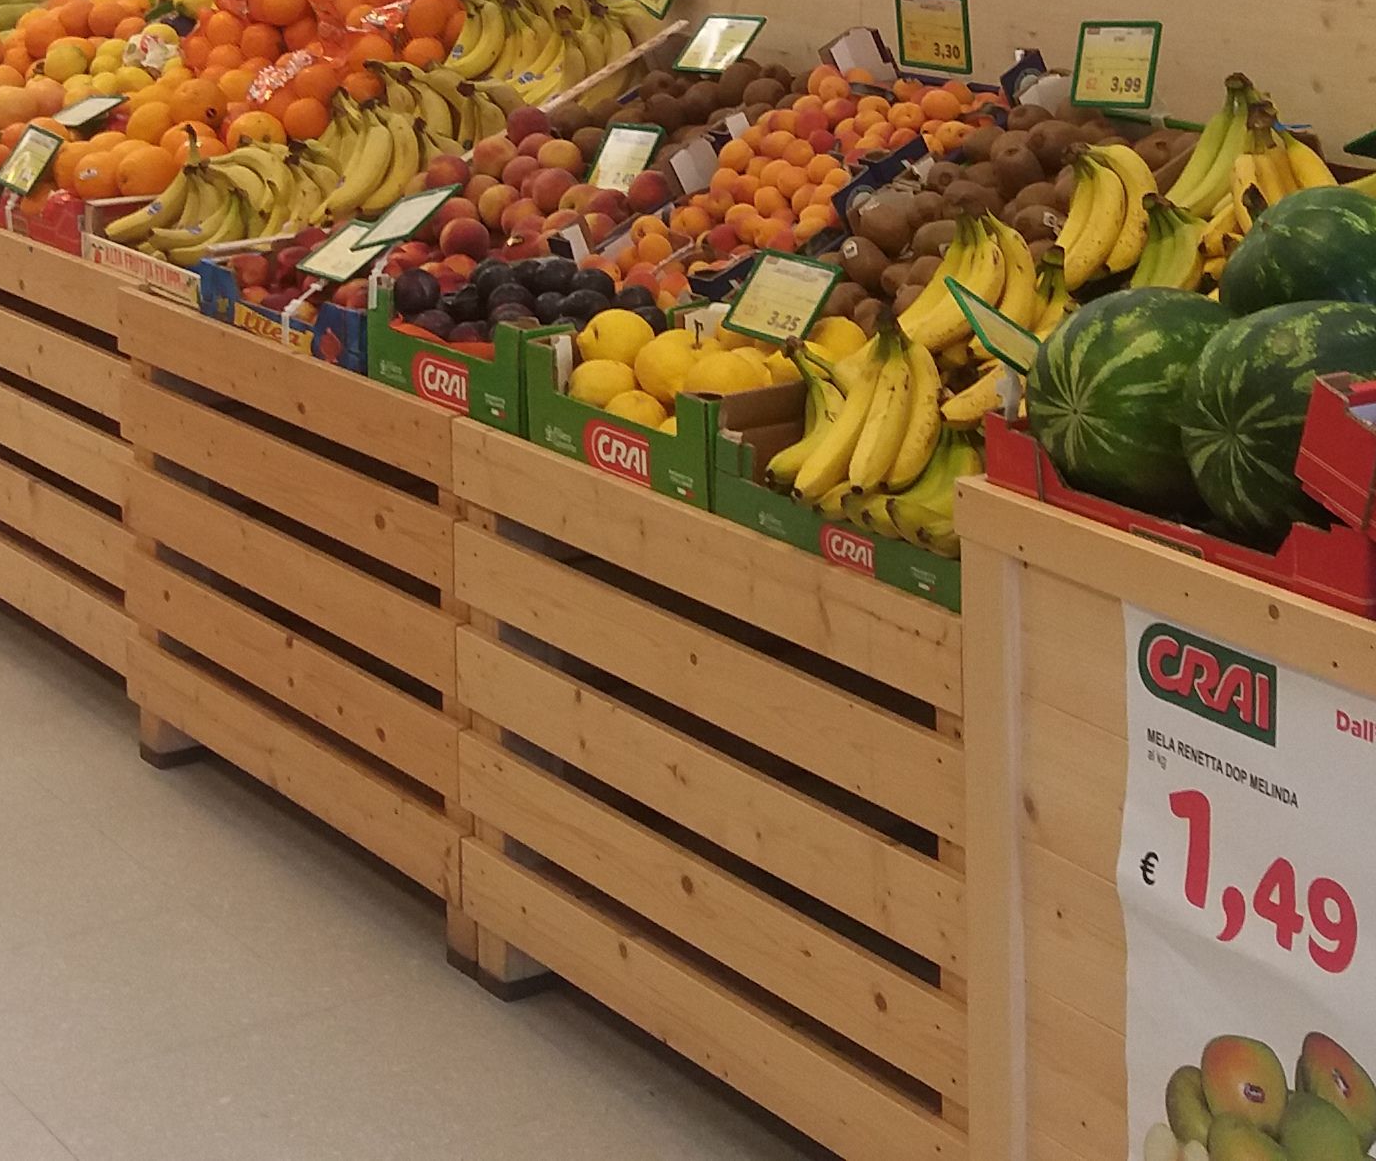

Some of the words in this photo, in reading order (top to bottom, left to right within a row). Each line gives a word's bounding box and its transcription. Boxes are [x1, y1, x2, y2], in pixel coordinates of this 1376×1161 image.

[424, 365, 468, 402] CRAI
[597, 435, 648, 477] CRAI
[830, 534, 873, 568] CRAI
[1146, 634, 1270, 732] CRAI
[1147, 728, 1175, 753] MELA
[1177, 741, 1224, 775] RENETTA
[1225, 762, 1248, 784] DOP
[1249, 774, 1299, 809] MELINDA
[1140, 851, 1159, 886] €
[1168, 789, 1358, 974] 1,49
